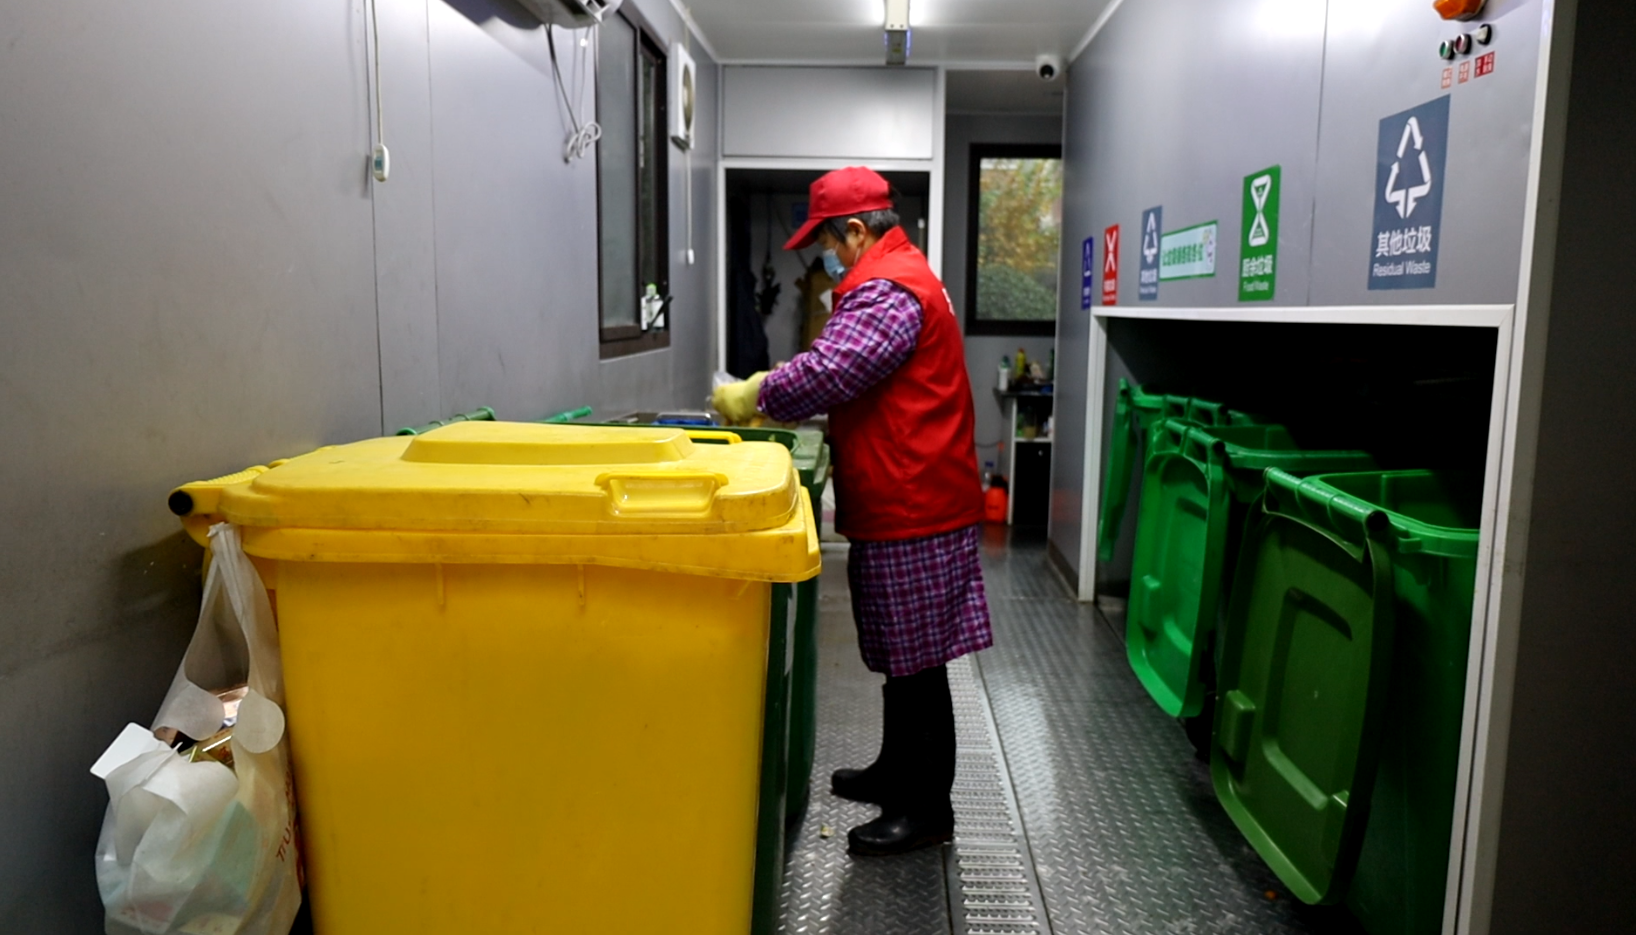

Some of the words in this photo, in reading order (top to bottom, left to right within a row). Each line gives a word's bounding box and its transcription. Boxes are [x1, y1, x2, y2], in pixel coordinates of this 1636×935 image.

[1375, 225, 1432, 257] 其他垃圾
[1373, 261, 1404, 278] Residual
[1405, 260, 1432, 275] Waste
